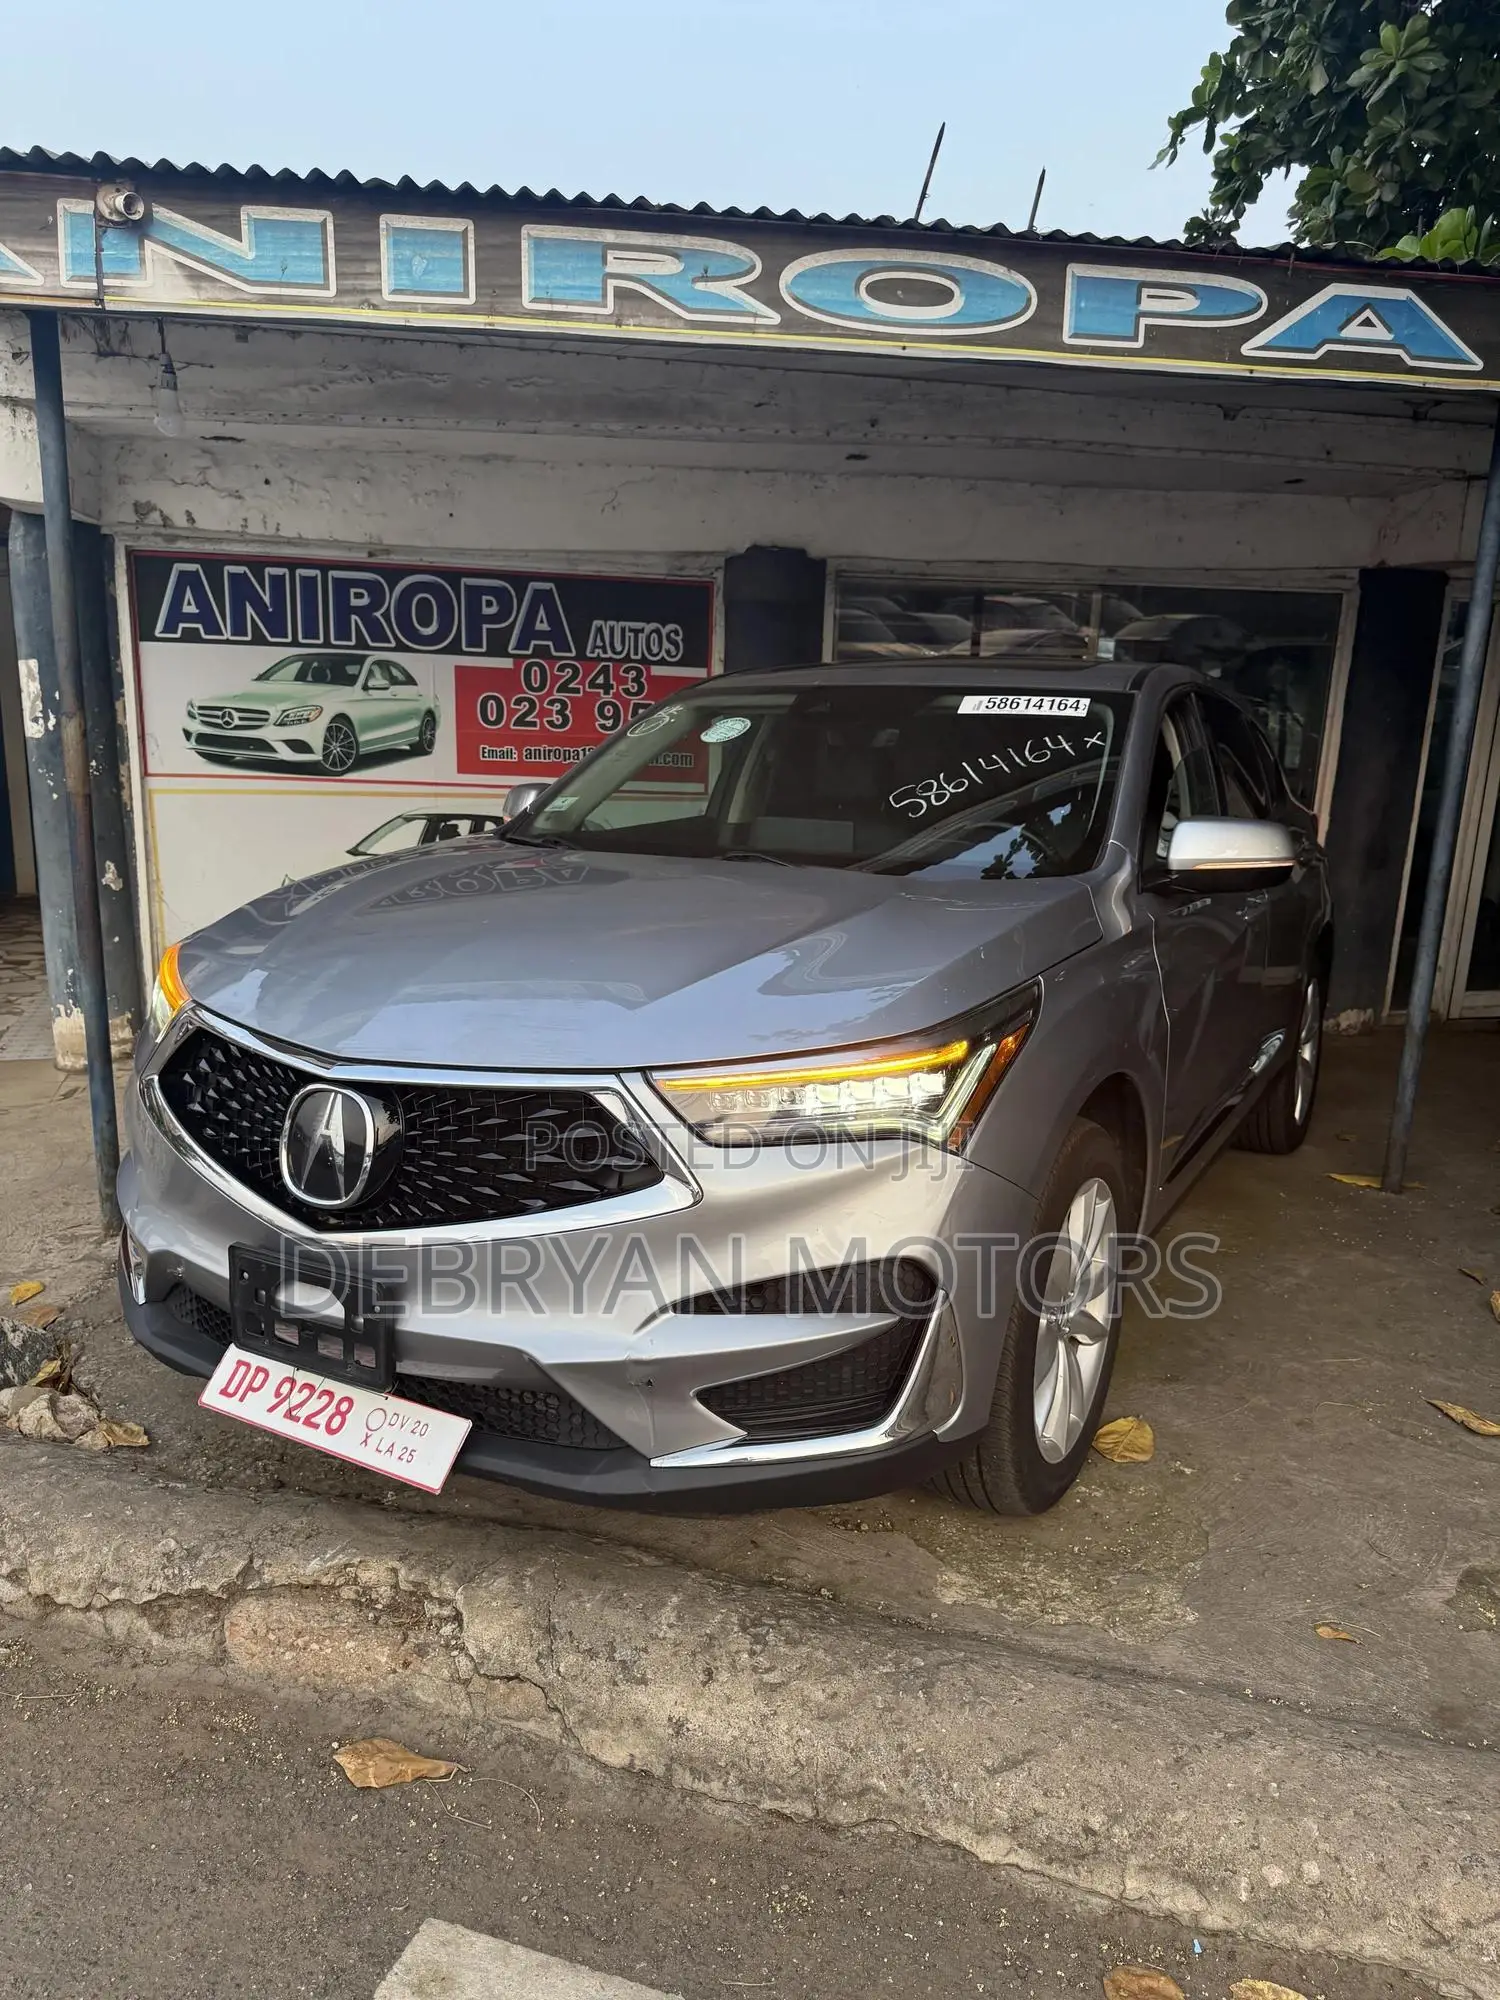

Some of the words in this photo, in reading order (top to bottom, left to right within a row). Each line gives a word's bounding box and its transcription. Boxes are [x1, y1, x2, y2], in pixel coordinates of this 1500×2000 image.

[0, 198, 1485, 372] NIROPA
[155, 563, 576, 656] ANIROPA
[586, 620, 683, 662] AUTOS
[520, 659, 648, 698] 0243
[985, 697, 1081, 711] 58614164
[477, 692, 572, 732] 023
[480, 745, 518, 761] Email:
[889, 734, 1076, 818] 58614164
[218, 1359, 270, 1403] DP
[266, 1376, 355, 1436] 9228
